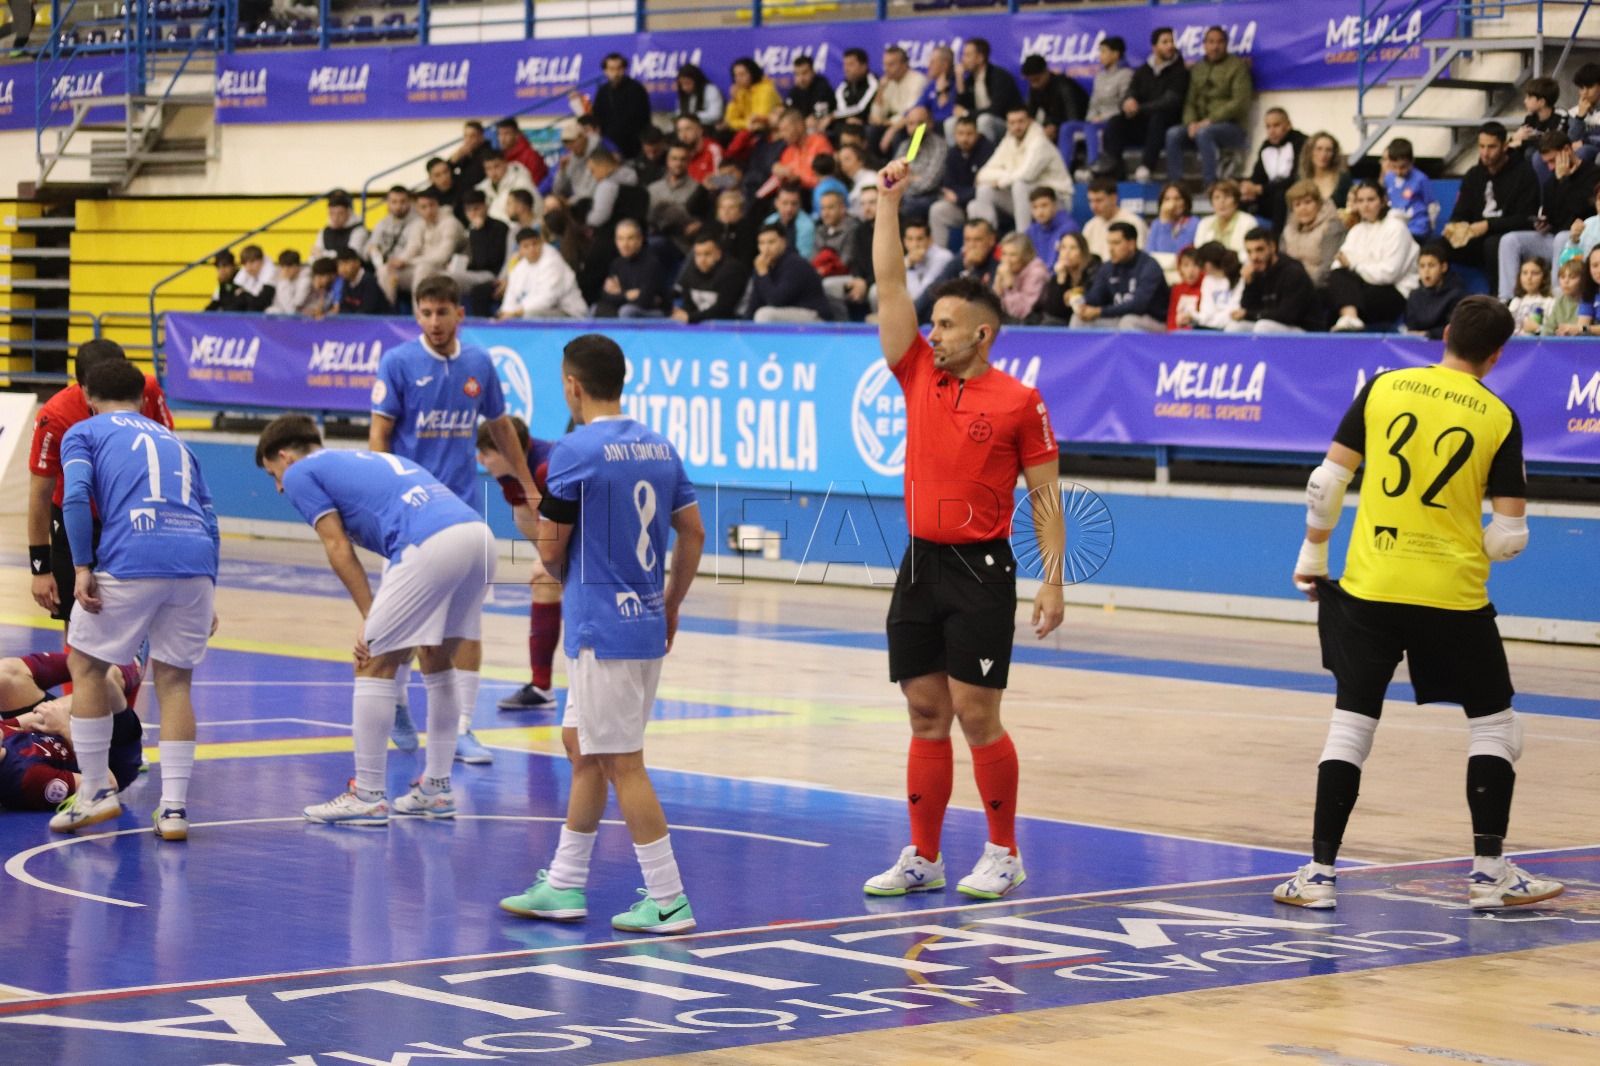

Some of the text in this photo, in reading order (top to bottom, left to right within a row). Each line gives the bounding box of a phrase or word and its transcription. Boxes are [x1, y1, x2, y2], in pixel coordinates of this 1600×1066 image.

[308, 63, 370, 93] MELILLA
[406, 59, 470, 89] MELILLA
[514, 54, 583, 85] MELILLA
[190, 334, 261, 369] MELILLA
[308, 340, 382, 373] MELILLA
[1155, 359, 1267, 402] MELILLA
[1392, 379, 1441, 400] GONZALO
[619, 384, 818, 472] ÚTBOL SALA
[131, 432, 193, 506] 17
[1382, 411, 1475, 510] 32
[633, 479, 657, 572] 8
[0, 901, 1347, 1047] MELILLA
[1053, 930, 1462, 983] CIUDAD
